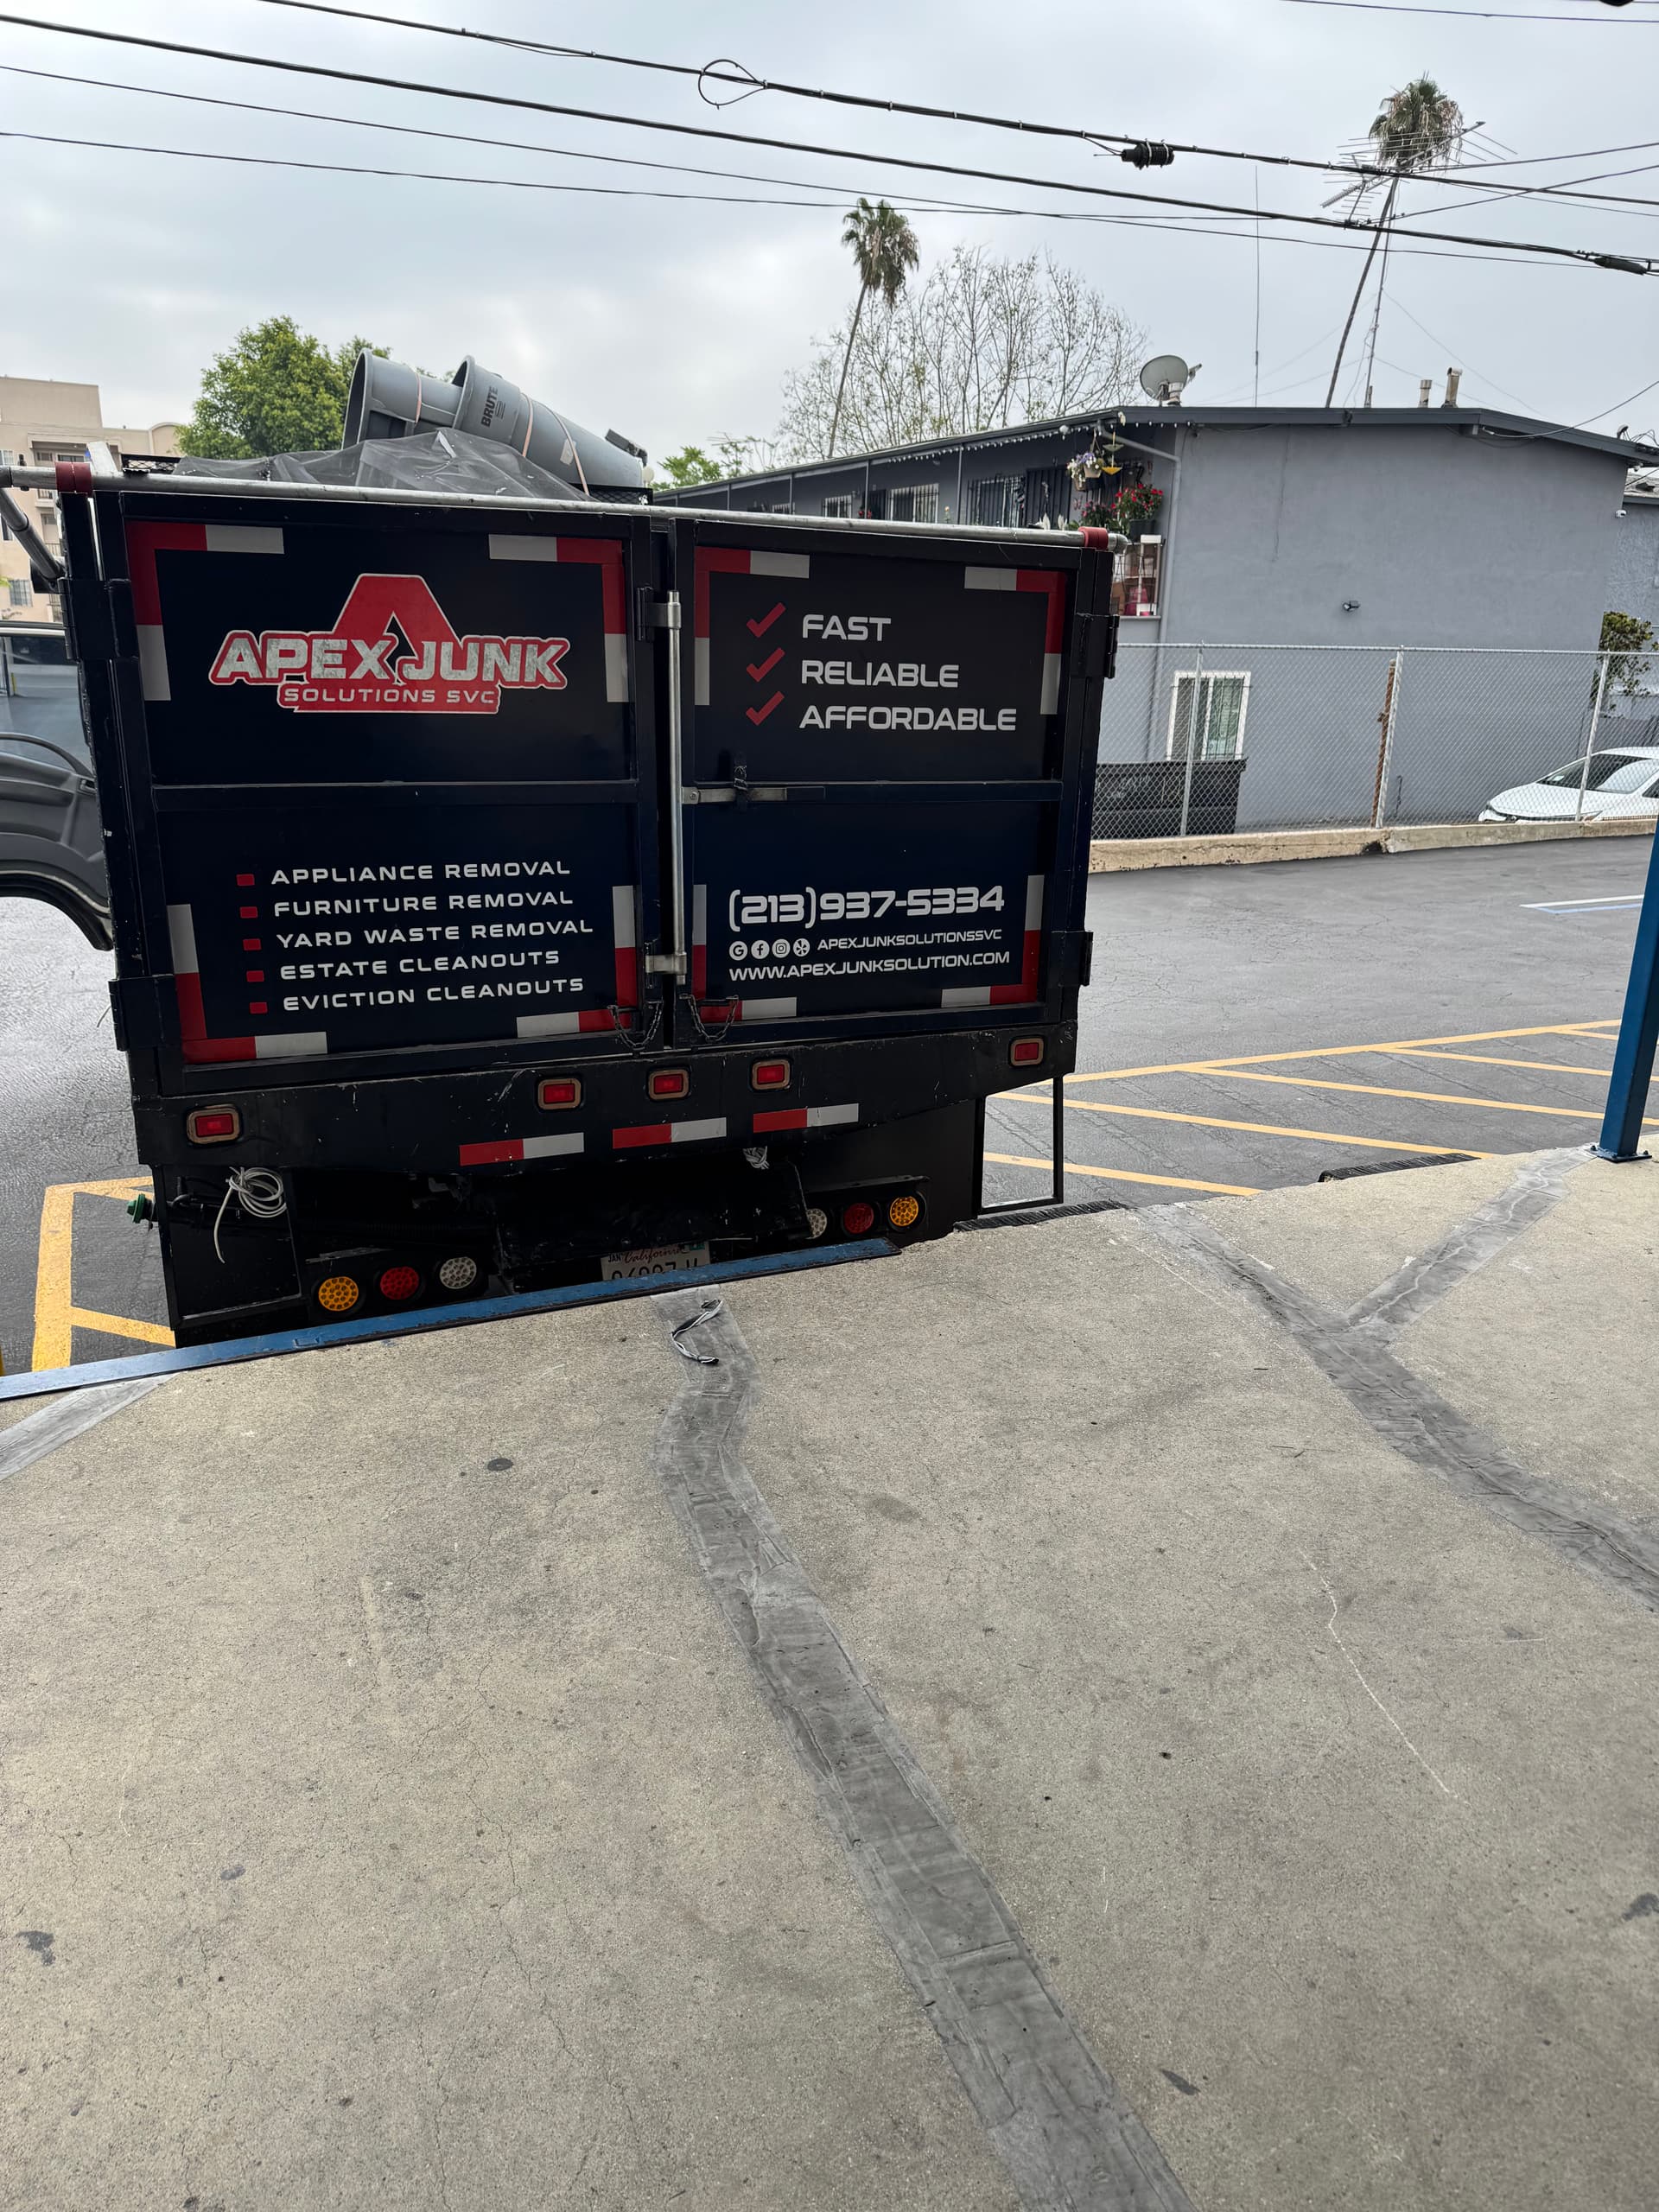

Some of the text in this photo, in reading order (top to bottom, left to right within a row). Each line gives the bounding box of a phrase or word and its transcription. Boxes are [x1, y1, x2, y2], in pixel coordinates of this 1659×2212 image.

[480, 385, 498, 428] BRUTE
[802, 613, 892, 642] FAST
[216, 637, 564, 683] APEX JUNK
[801, 659, 959, 688] RELIABLE
[283, 688, 495, 704] SOLUTIONS SVC
[798, 705, 1017, 731] AFFORDABLE
[270, 861, 570, 885] APPLIANCE REMOVAL
[274, 891, 574, 917] FURNITURE REMOVAL
[728, 885, 1005, 932] (213)937-5334
[276, 919, 594, 949] YARD WASTE REMOVAL
[817, 929, 1002, 950] APEXJUNKSOLUTIONSSVC
[280, 950, 559, 980] ESTATE CLEANOUTS
[728, 951, 1010, 982] WWW.APEXJUNKSOLUTION.COM
[283, 977, 583, 1011] EVICTION CLEANOUTS
